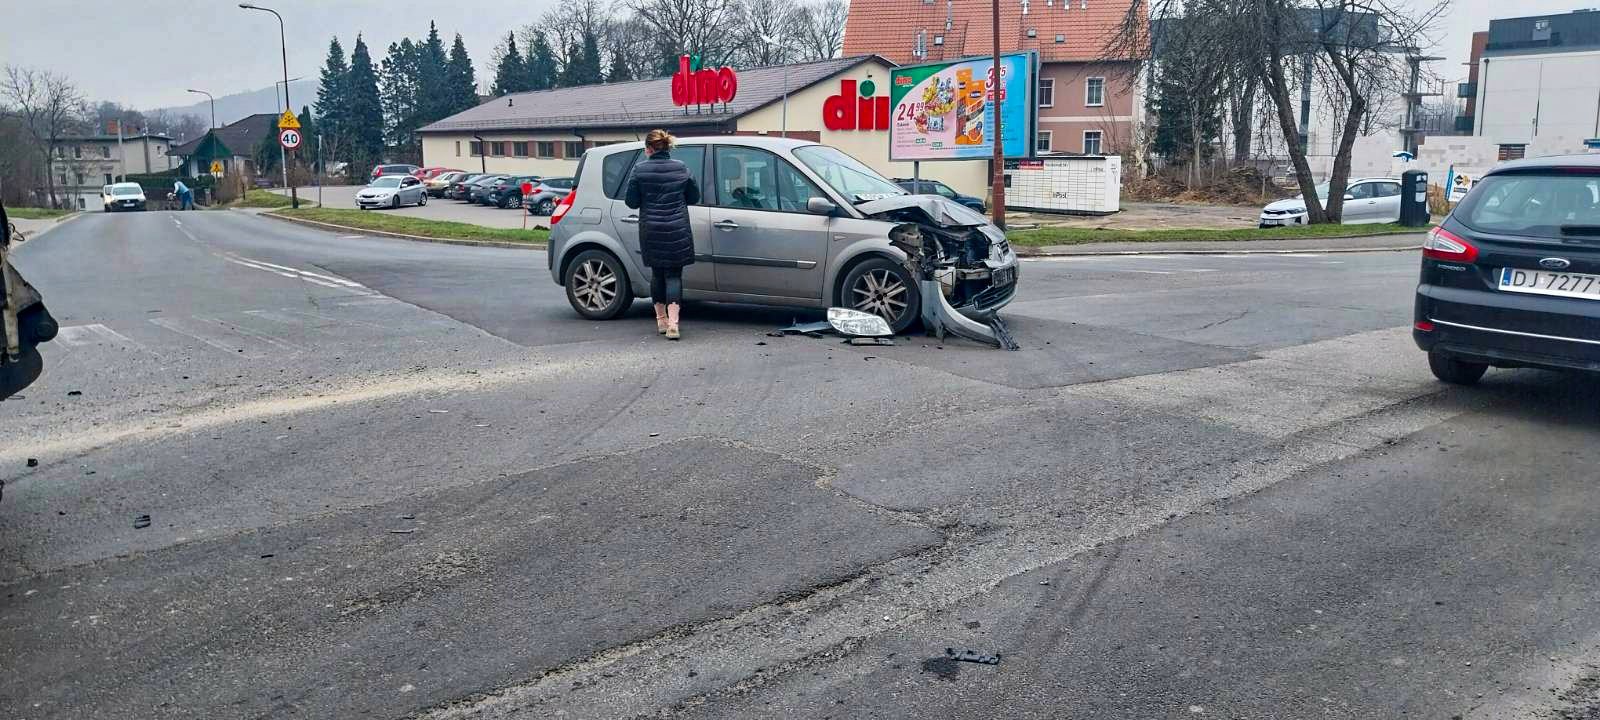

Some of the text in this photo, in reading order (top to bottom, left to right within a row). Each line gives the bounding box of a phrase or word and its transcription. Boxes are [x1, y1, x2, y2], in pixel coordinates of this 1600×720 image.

[672, 54, 737, 106] dino
[283, 134, 298, 144] 40
[1512, 271, 1600, 294] DJ 7277
